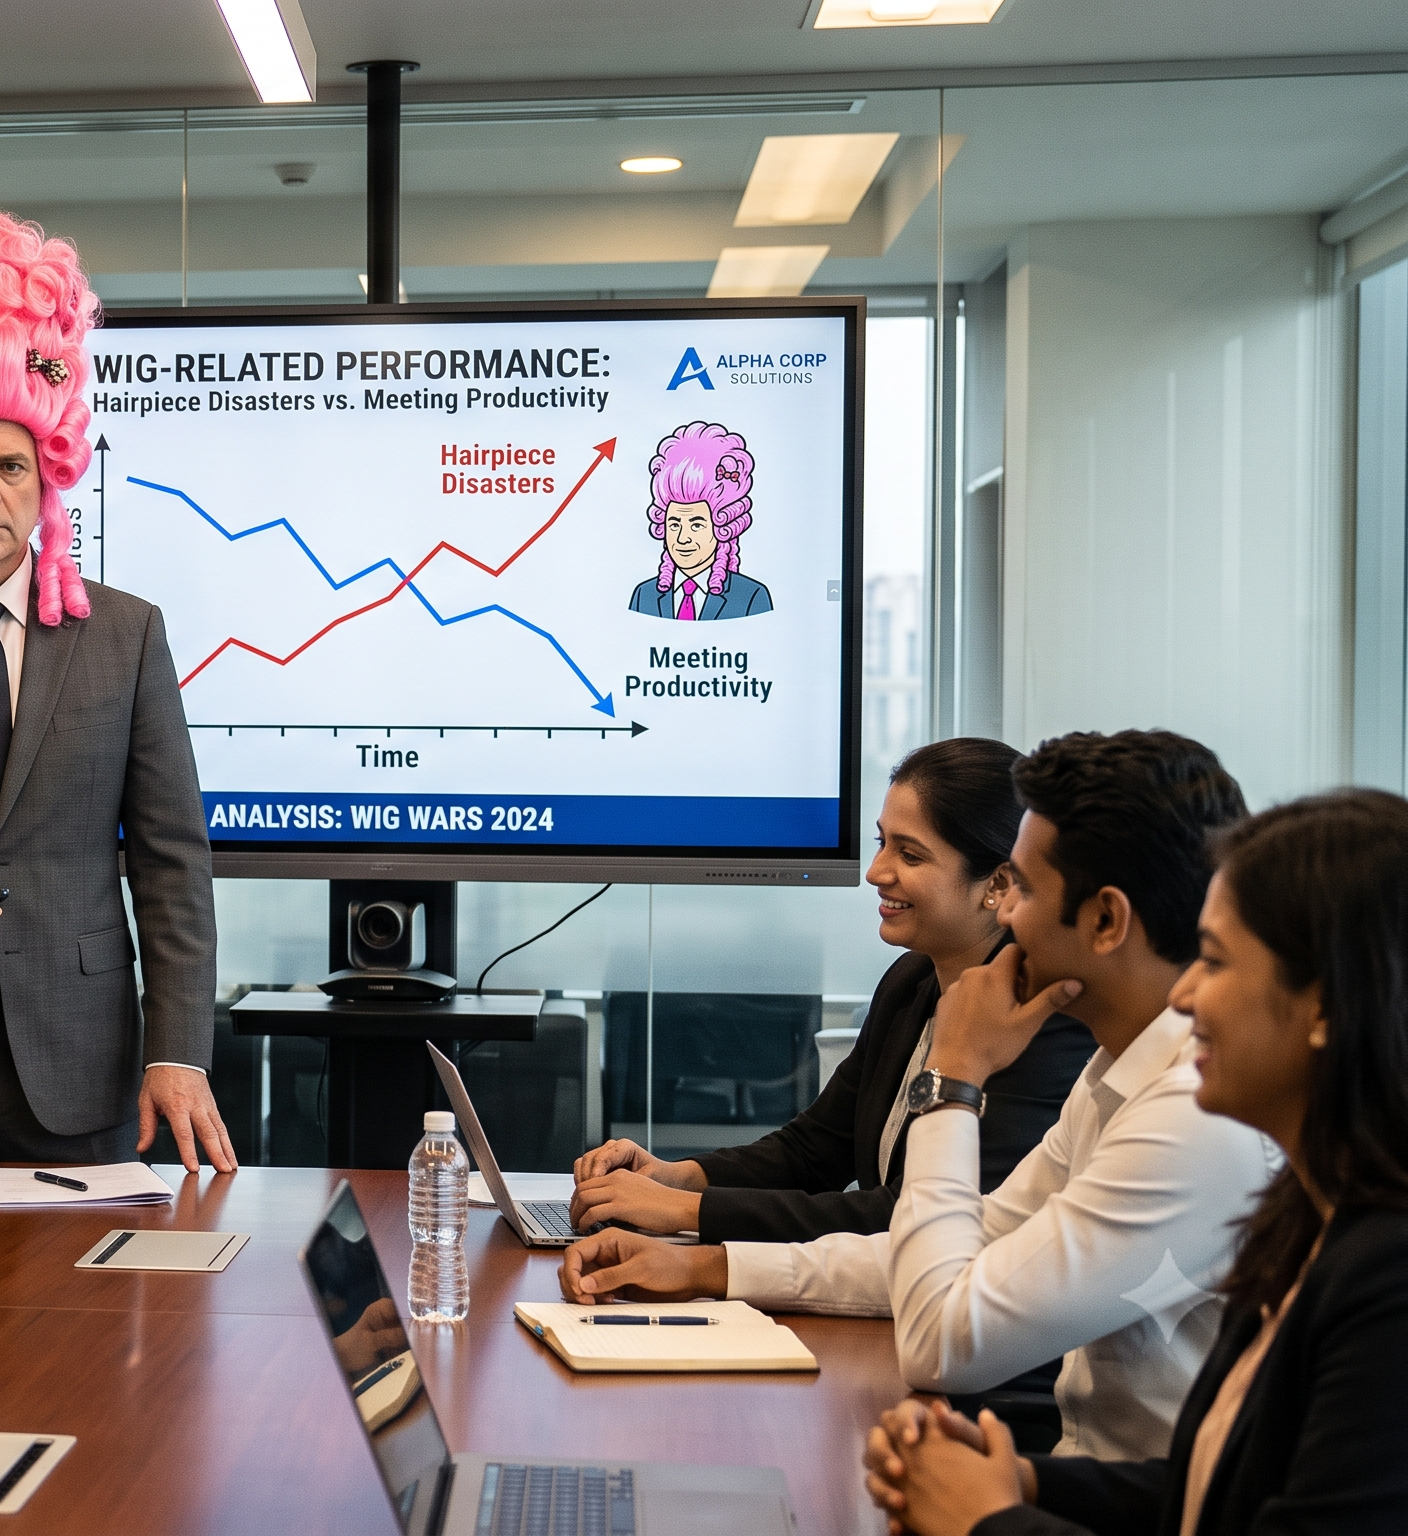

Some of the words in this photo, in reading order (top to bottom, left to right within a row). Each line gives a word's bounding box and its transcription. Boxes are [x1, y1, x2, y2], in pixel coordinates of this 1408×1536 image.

[93, 351, 324, 383] WIG-RELATED
[336, 347, 611, 380] PERFORMANCE:
[716, 354, 774, 368] ALPHA
[779, 353, 827, 367] CORP
[730, 372, 813, 384] SOLUTIONS
[93, 391, 201, 417] Hairpiece
[208, 389, 316, 411] Disasters
[322, 393, 355, 410] vs.
[364, 387, 458, 414] Meeting
[466, 386, 610, 413] Productivity
[441, 443, 556, 471] Hairpiece
[442, 472, 555, 495] Disasters
[649, 646, 748, 675] Meeting
[625, 674, 774, 704] Productivity
[355, 743, 420, 769] Time
[209, 804, 342, 829] ANALYSIS:
[350, 805, 400, 830] WIG
[407, 805, 483, 831] WARS
[490, 806, 554, 832] 2024
